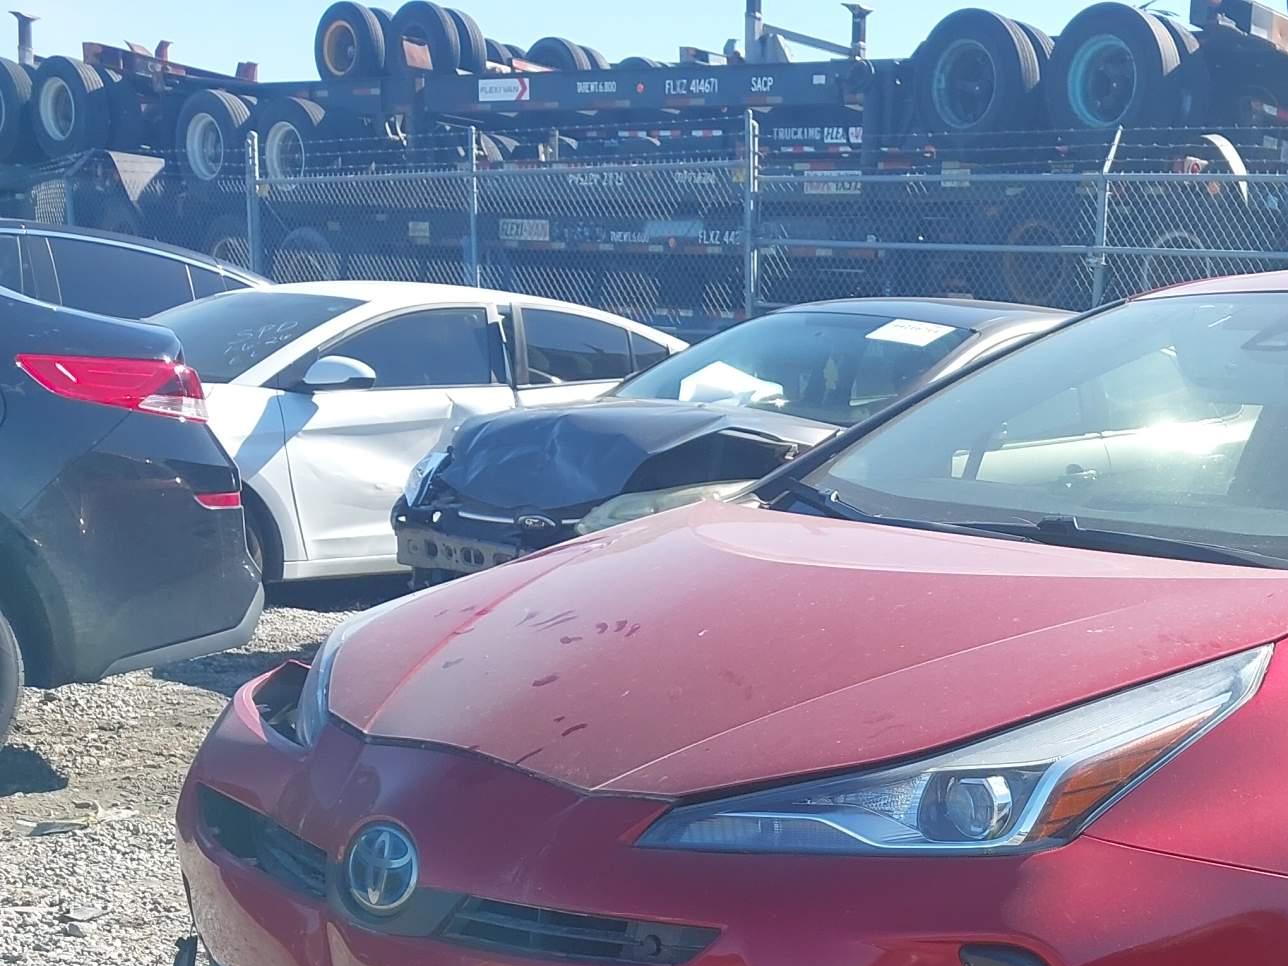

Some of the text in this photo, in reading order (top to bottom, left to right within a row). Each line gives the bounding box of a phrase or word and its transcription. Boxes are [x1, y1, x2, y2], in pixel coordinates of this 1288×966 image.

[665, 78, 718, 94] FLXZ 414671
[751, 77, 774, 92] SACP
[773, 127, 821, 141] TRUCKING
